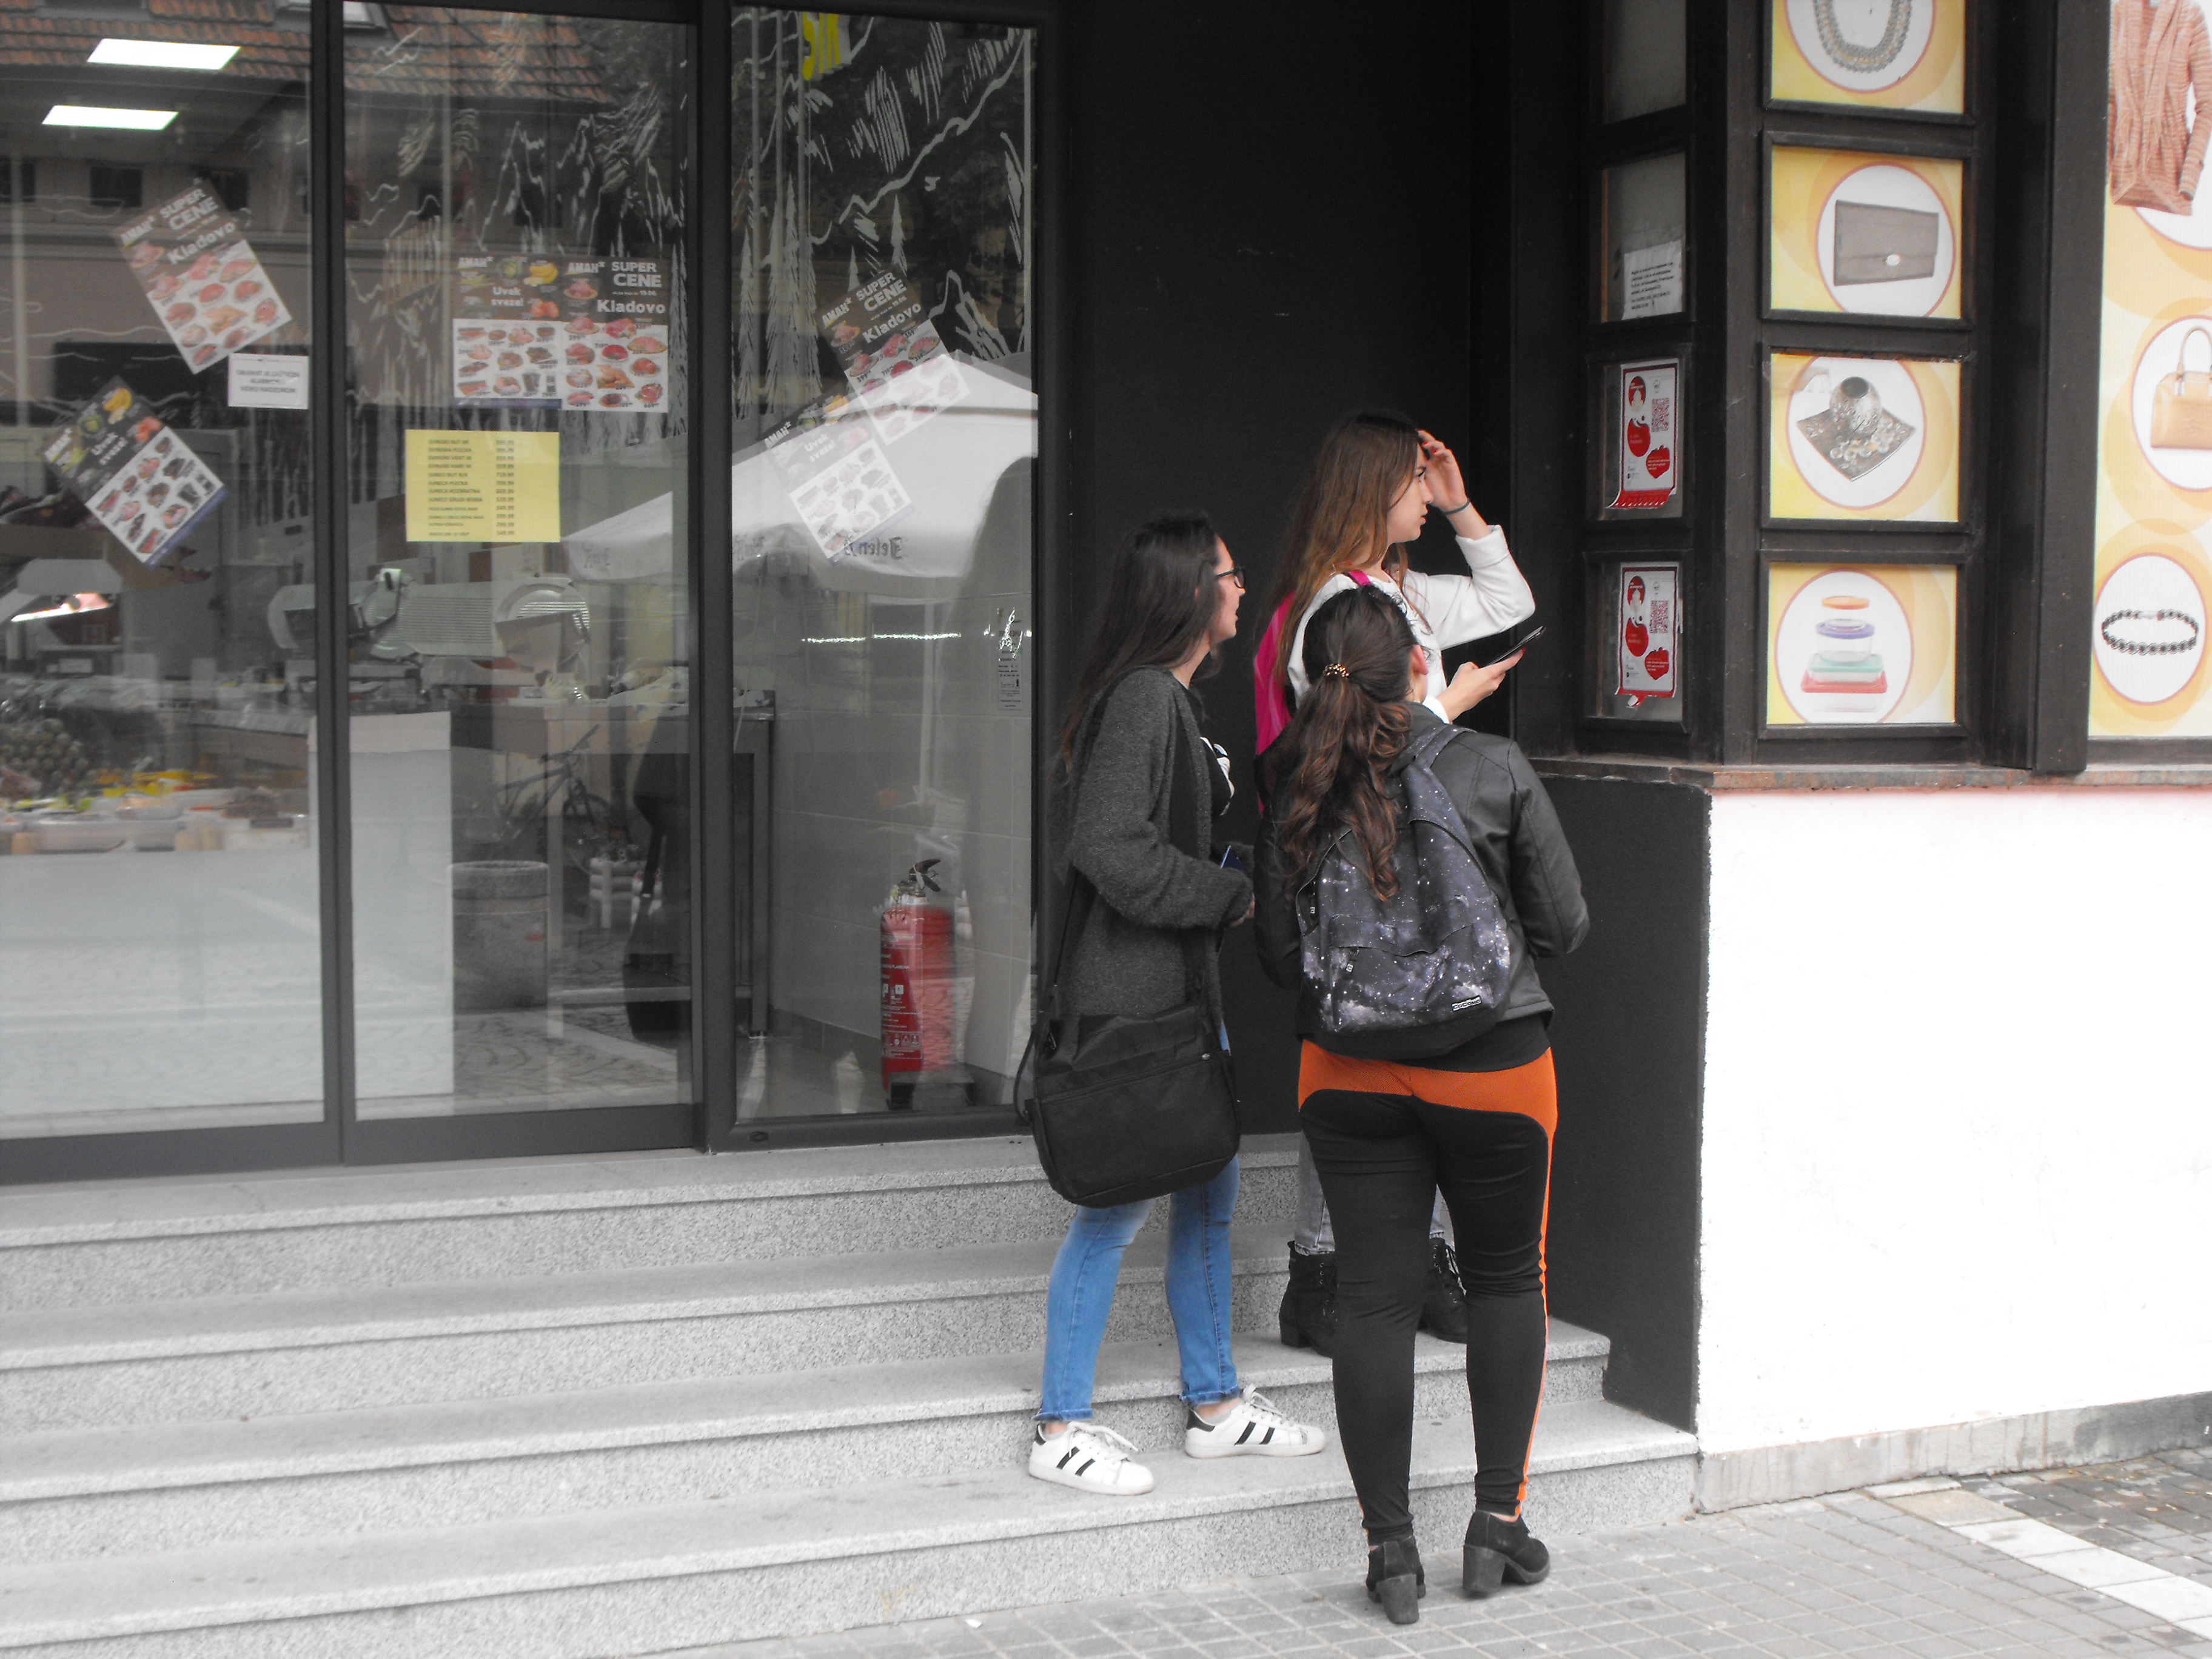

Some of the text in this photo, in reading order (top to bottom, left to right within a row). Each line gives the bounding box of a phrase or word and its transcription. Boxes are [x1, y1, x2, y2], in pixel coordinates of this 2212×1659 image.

[159, 189, 206, 218] SUPER
[169, 196, 218, 230] CENE
[167, 223, 235, 264] Kladovo
[611, 261, 657, 272] SUPER
[613, 273, 662, 288] CENE
[492, 286, 521, 296] Uvek
[856, 273, 896, 301] SUPER
[863, 279, 907, 311] CENE
[597, 300, 666, 314] Kladovo
[862, 303, 922, 344] Kladovo
